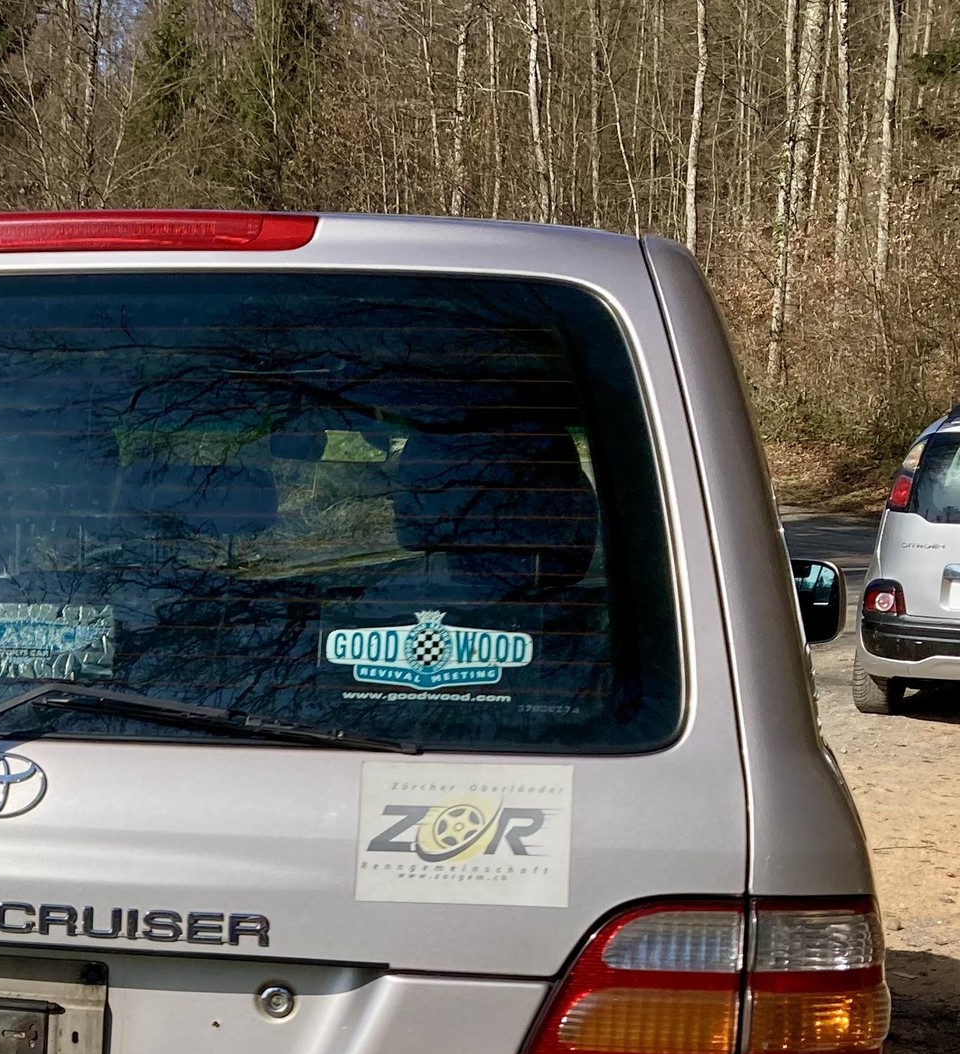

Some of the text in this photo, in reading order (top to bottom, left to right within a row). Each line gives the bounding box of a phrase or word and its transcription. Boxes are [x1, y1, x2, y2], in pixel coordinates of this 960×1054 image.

[334, 630, 398, 662] GOOD
[455, 631, 526, 663] WOOD
[359, 667, 496, 683] REVIVAL MEETING
[342, 690, 512, 703] www.goodwood.com
[391, 781, 565, 794] Zürcher Oberländer
[360, 861, 549, 875] Renngemeinschaft
